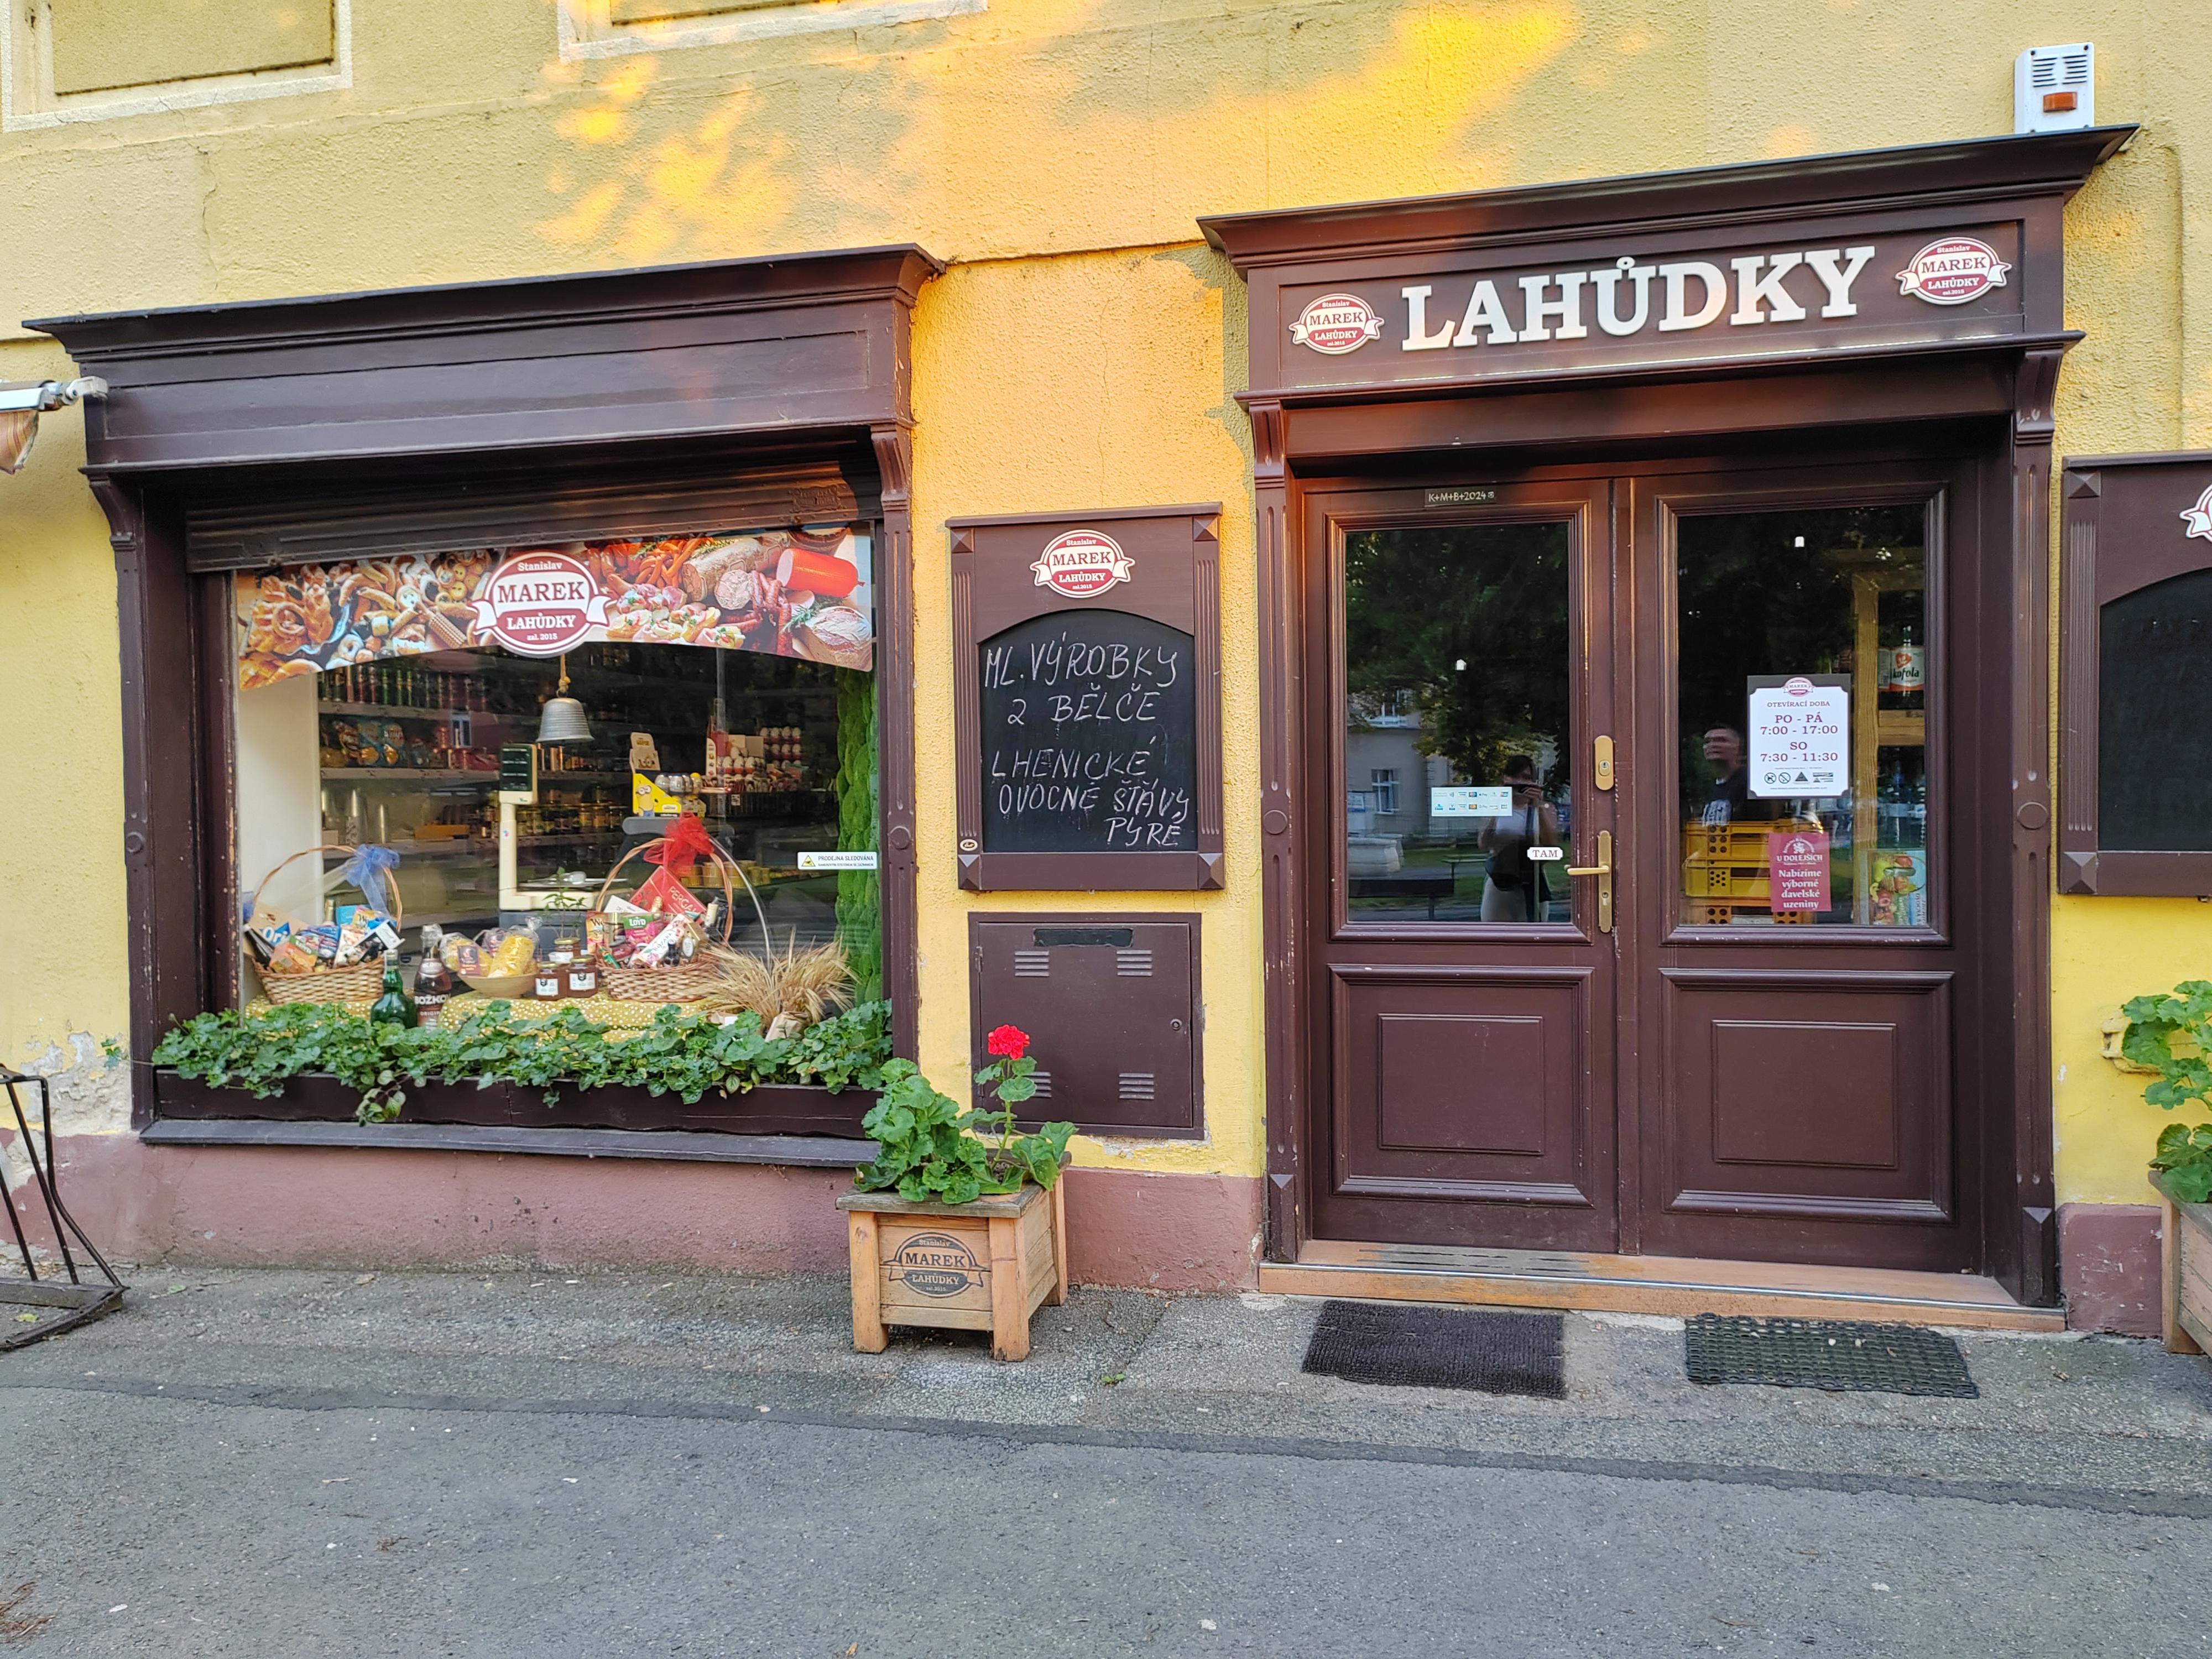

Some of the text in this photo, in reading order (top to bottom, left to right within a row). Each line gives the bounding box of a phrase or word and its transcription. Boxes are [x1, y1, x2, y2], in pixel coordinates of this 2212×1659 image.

[1937, 245, 1970, 253] Stanislav
[1921, 257, 1986, 273] MAREK
[1928, 277, 1980, 290] LAHŮDKY
[1402, 246, 1875, 351] LAHŮDKY
[1310, 312, 1363, 326] MAREK
[1314, 329, 1357, 341] LAHŮDKY
[1052, 551, 1112, 566] MAREK
[518, 561, 562, 571] Stanislav
[1058, 571, 1106, 583] LAHŮDKY
[498, 581, 585, 603] MAREK
[507, 612, 576, 630] LAHŮDKY
[1030, 631, 1178, 687] VÝROBKY
[1893, 666, 1919, 680] kofola
[1048, 682, 1161, 722] BĚLČE
[1775, 715, 1792, 723] PO
[1806, 712, 1823, 723] PÁ
[1760, 726, 1788, 735] 7:00
[1802, 725, 1838, 734] 17:00
[1790, 742, 1808, 750] SO
[992, 735, 1156, 780] LHENICKÉ
[1760, 753, 1788, 762] 7:30
[1802, 753, 1838, 761] 11:30
[999, 781, 1100, 815] OVOCNÉ
[1104, 812, 1181, 846] PYRÉ
[1532, 849, 1558, 858] TAM
[1783, 853, 1823, 862] DOLEJŠÍCH
[1778, 869, 1822, 877] Nabízíme
[1782, 879, 1819, 890] výborné
[1781, 889, 1820, 898] davelské
[1783, 900, 1819, 910] uzeniny
[629, 918, 646, 926] LOYD
[905, 1253, 966, 1267] MAREK
